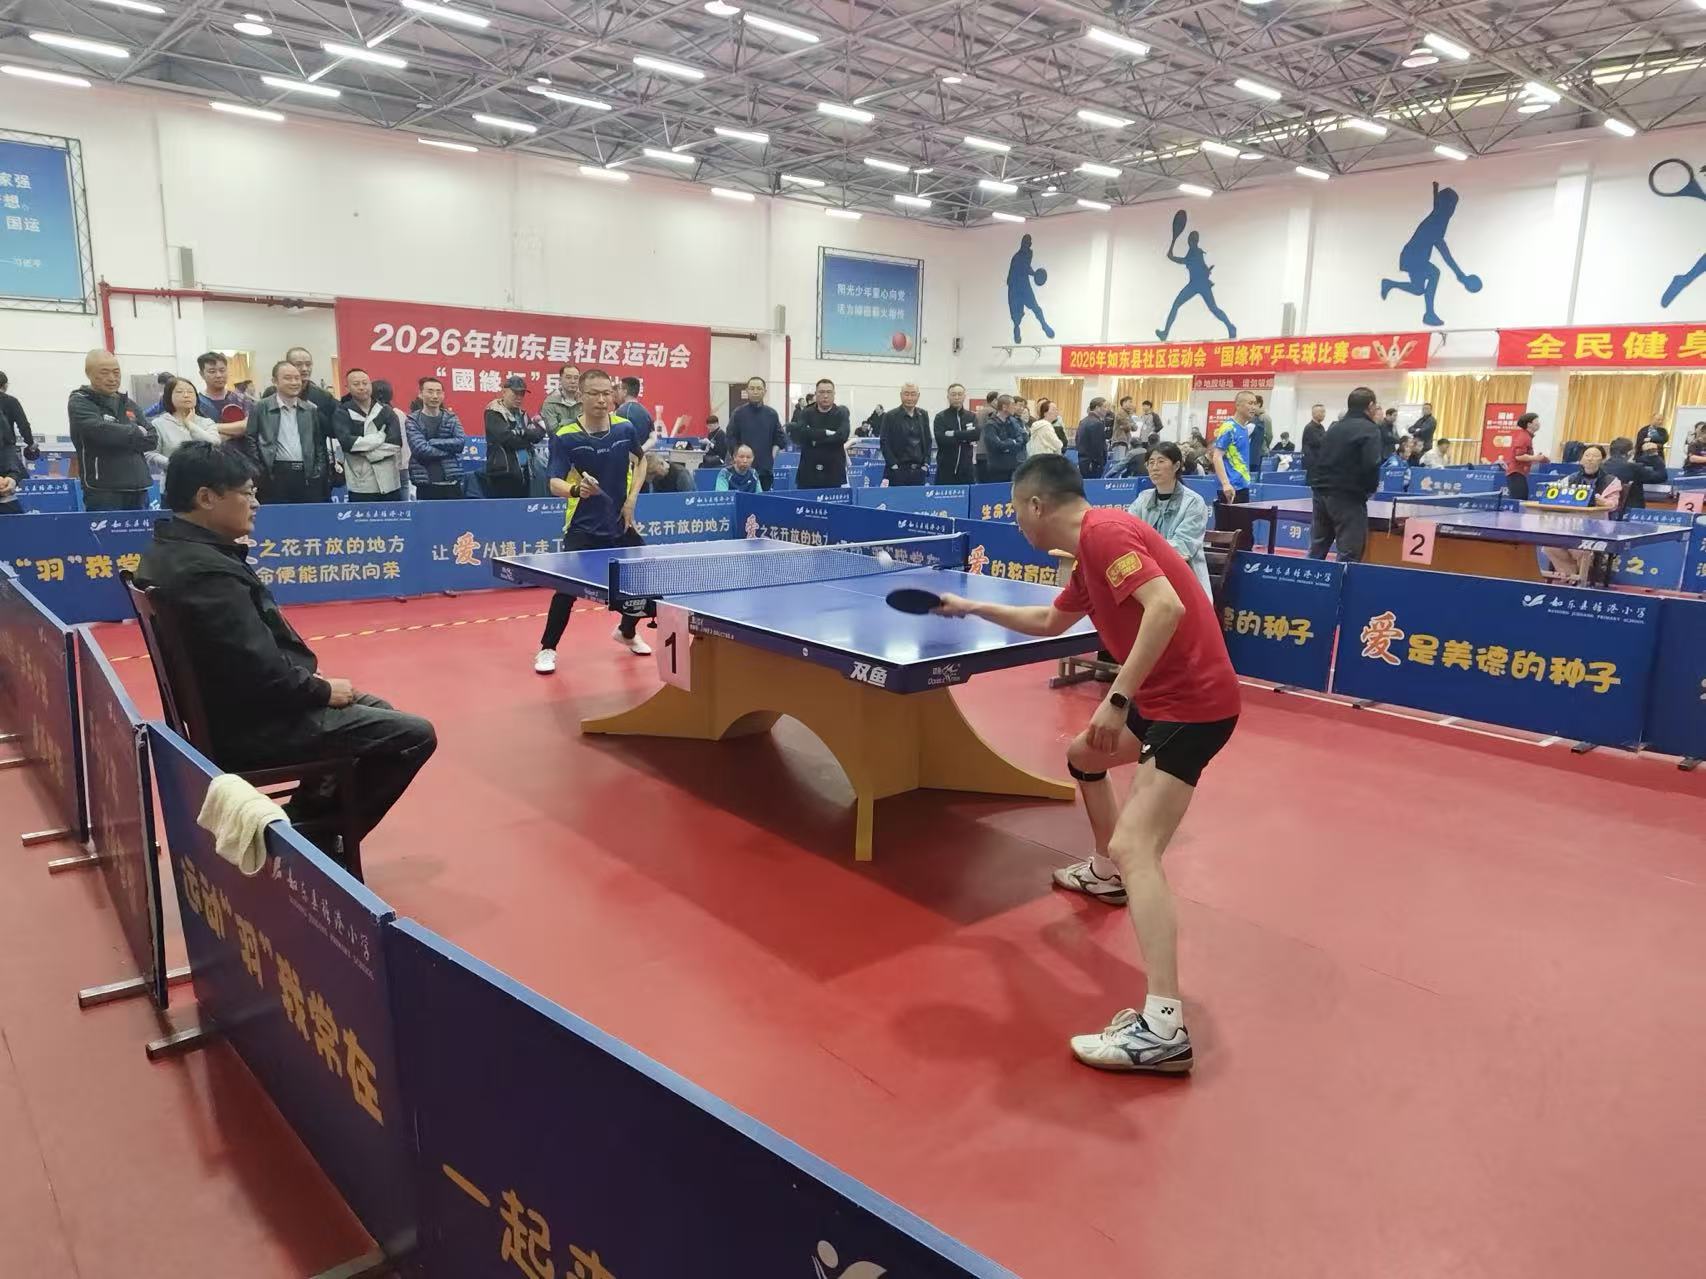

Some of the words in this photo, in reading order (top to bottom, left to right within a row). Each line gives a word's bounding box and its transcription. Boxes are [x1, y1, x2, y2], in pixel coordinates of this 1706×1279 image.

[370, 323, 692, 369] 2026年如东县社区运动会
[1070, 348, 1207, 369] 2026年如东县社区运动会
[236, 534, 405, 562] 之花开放的地方
[1410, 533, 1426, 556] 2
[664, 632, 678, 675] 1
[1361, 611, 1622, 694] 爱是美德的种子
[850, 661, 888, 688] 双鱼
